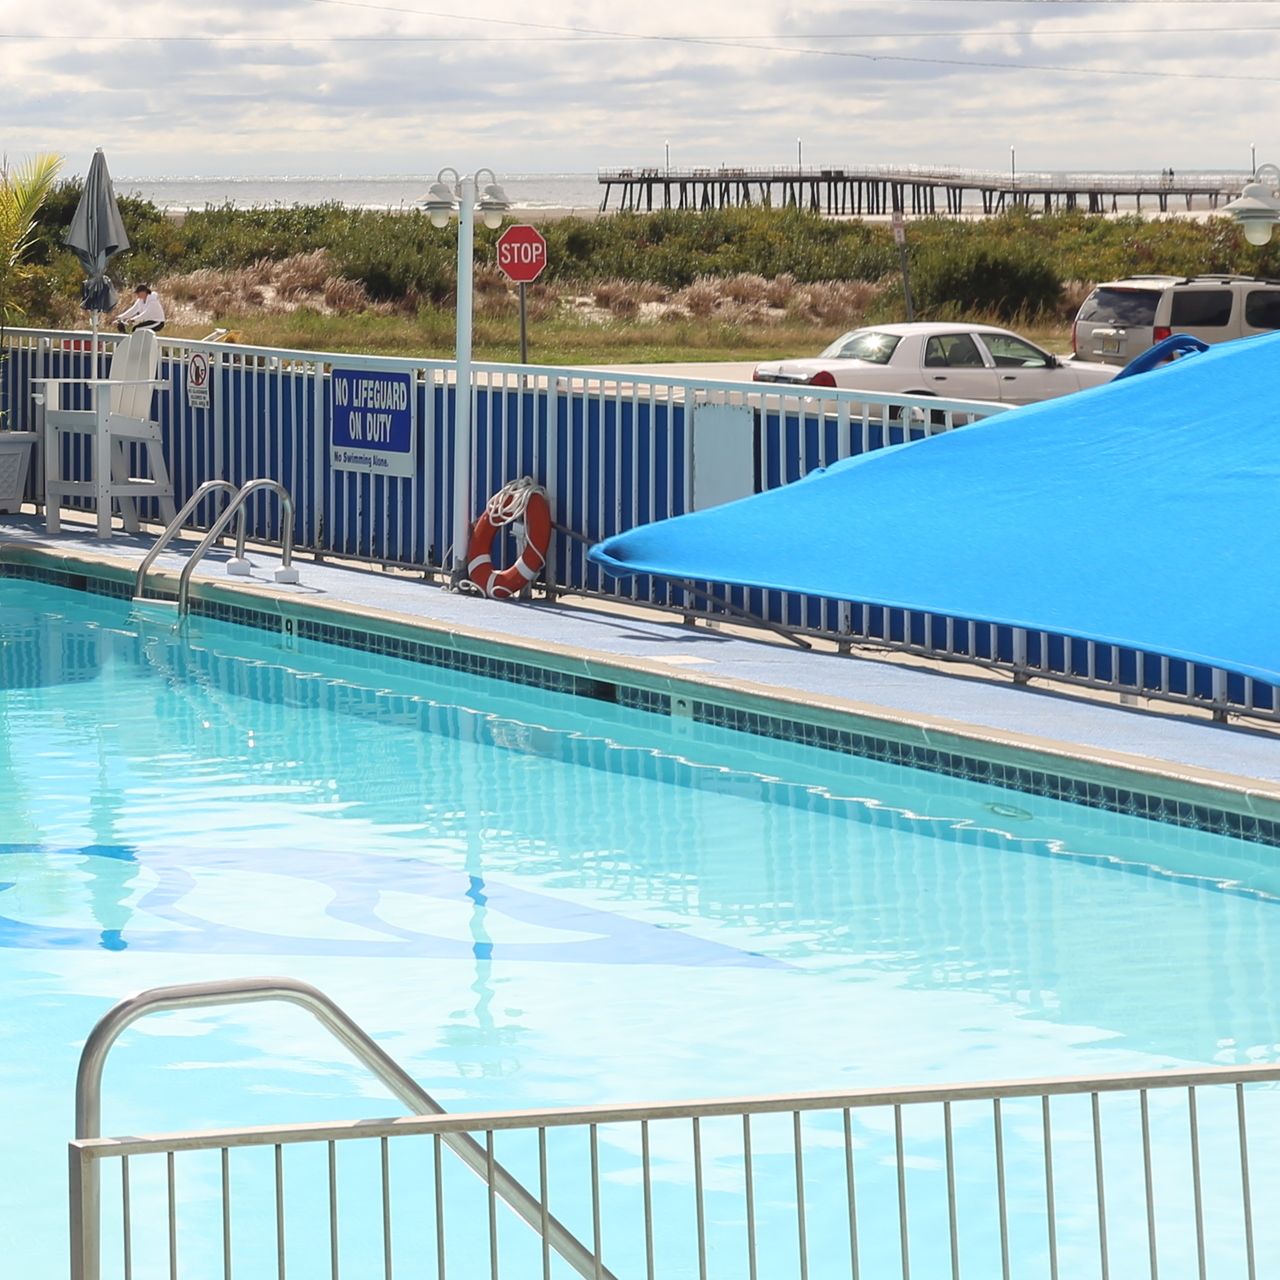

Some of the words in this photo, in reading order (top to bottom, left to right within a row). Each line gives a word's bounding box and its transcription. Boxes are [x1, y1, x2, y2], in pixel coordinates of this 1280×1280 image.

[501, 242, 542, 264] STOP
[335, 377, 349, 407] NO
[352, 378, 407, 411] LIFEGUARD
[349, 411, 362, 440] ON
[366, 412, 392, 443] DUTY
[334, 451, 342, 463] No
[343, 452, 372, 468] Swimming
[285, 618, 293, 636] 9
